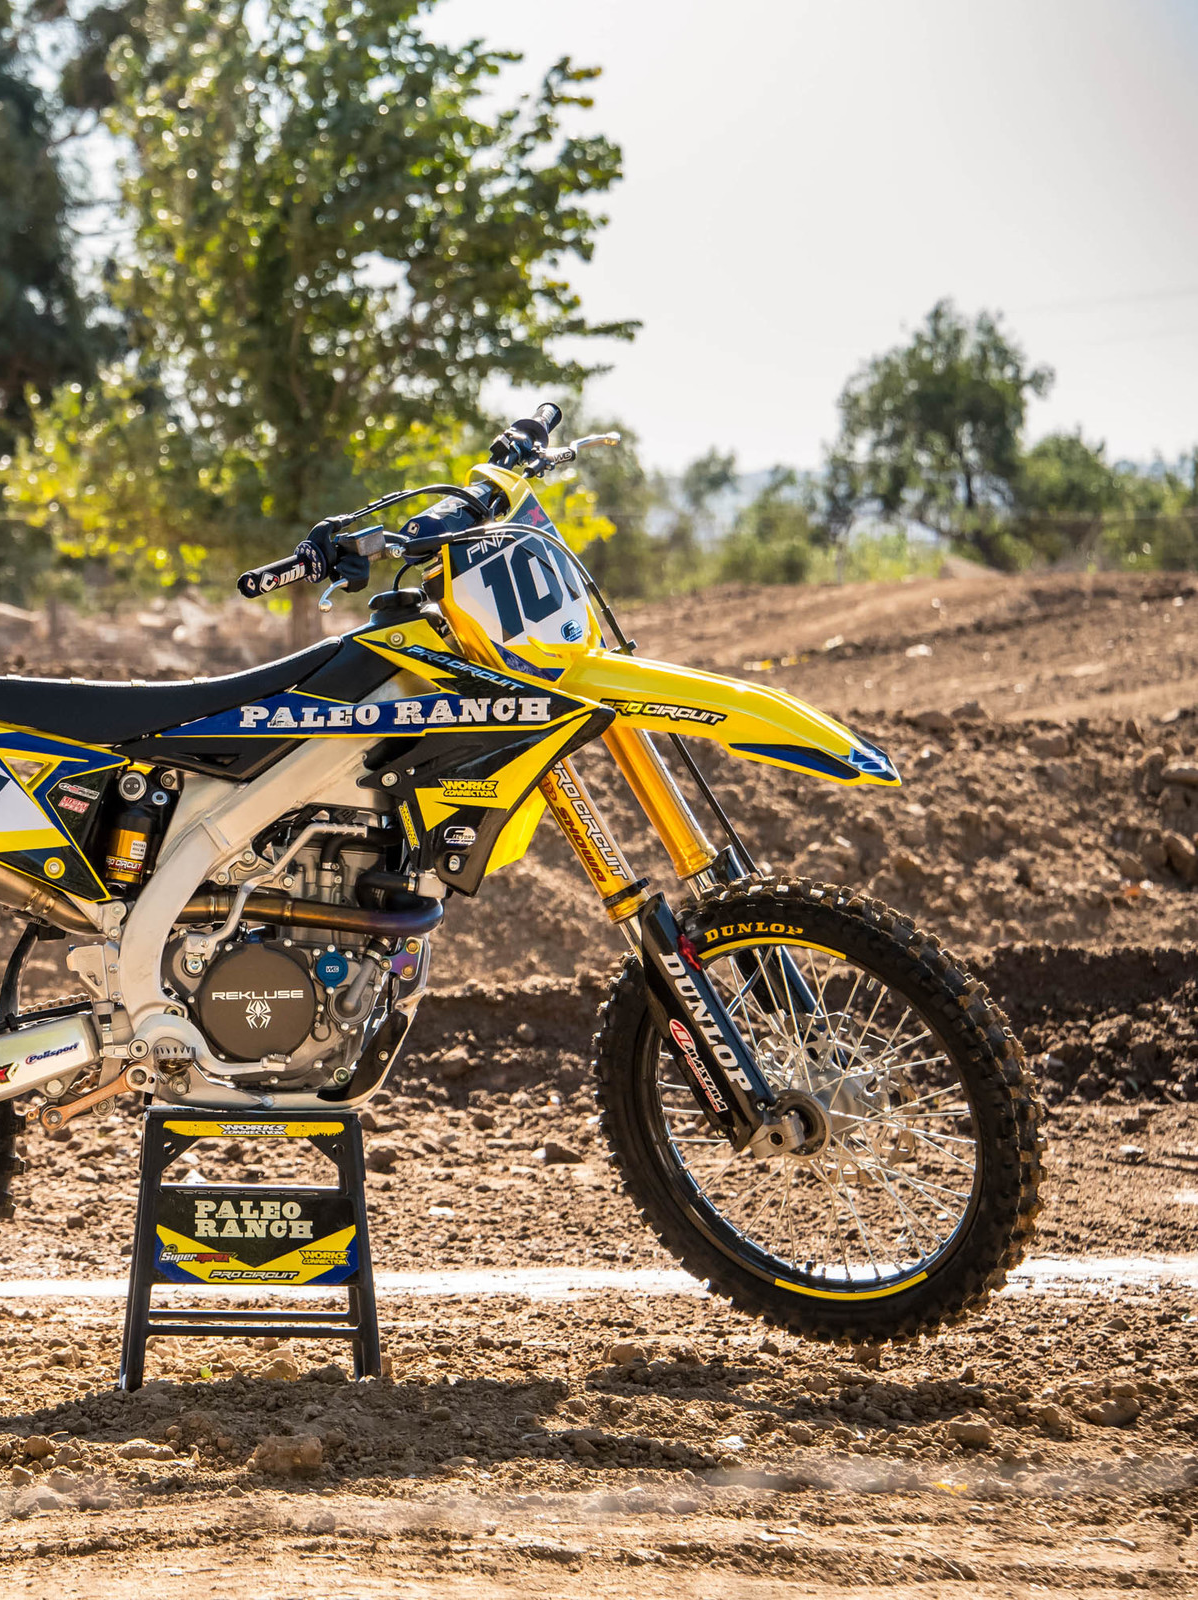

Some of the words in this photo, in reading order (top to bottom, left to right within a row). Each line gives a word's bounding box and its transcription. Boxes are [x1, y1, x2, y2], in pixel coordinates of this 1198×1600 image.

[407, 647, 448, 665] PRO
[446, 661, 525, 691] CIRCUIT
[239, 704, 381, 728] PALEO
[394, 697, 552, 725] RANCH
[642, 703, 724, 724] CIRCUIT
[442, 780, 498, 790] WORKS
[443, 789, 497, 797] CONNECTION
[557, 806, 607, 882] SHOWA
[571, 799, 629, 880] CIRCUIT
[704, 922, 804, 943] DUNLOP
[211, 989, 304, 1001] REKLUSE
[658, 951, 753, 1092] DUNLOP
[26, 1042, 79, 1064] Polisport
[194, 1200, 301, 1219] PALEO
[194, 1219, 314, 1238] RANCH
[301, 1251, 348, 1259] WORKS
[210, 1271, 240, 1280] PRO
[239, 1271, 298, 1280] CIRCUIT
